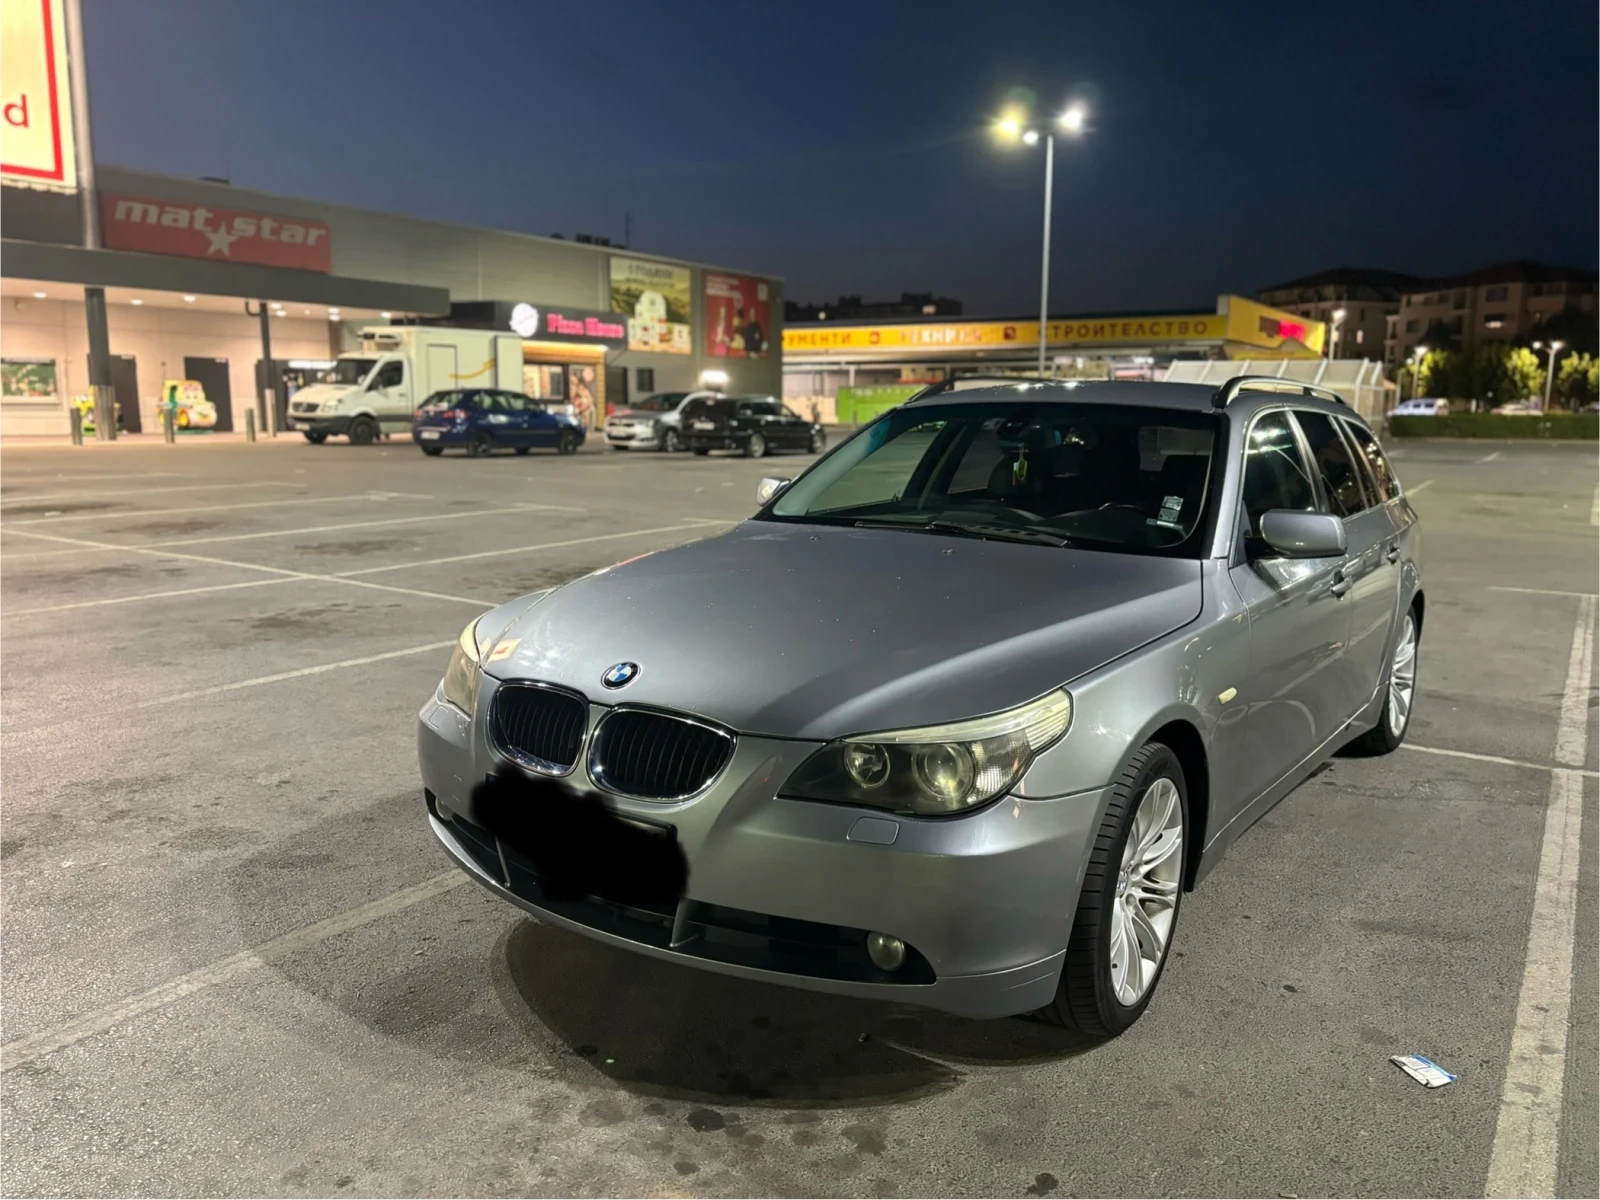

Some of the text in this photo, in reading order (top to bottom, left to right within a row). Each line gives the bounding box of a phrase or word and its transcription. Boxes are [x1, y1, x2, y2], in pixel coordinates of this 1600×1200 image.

[114, 200, 327, 246] mat star
[781, 331, 852, 347] УМЕНТИ
